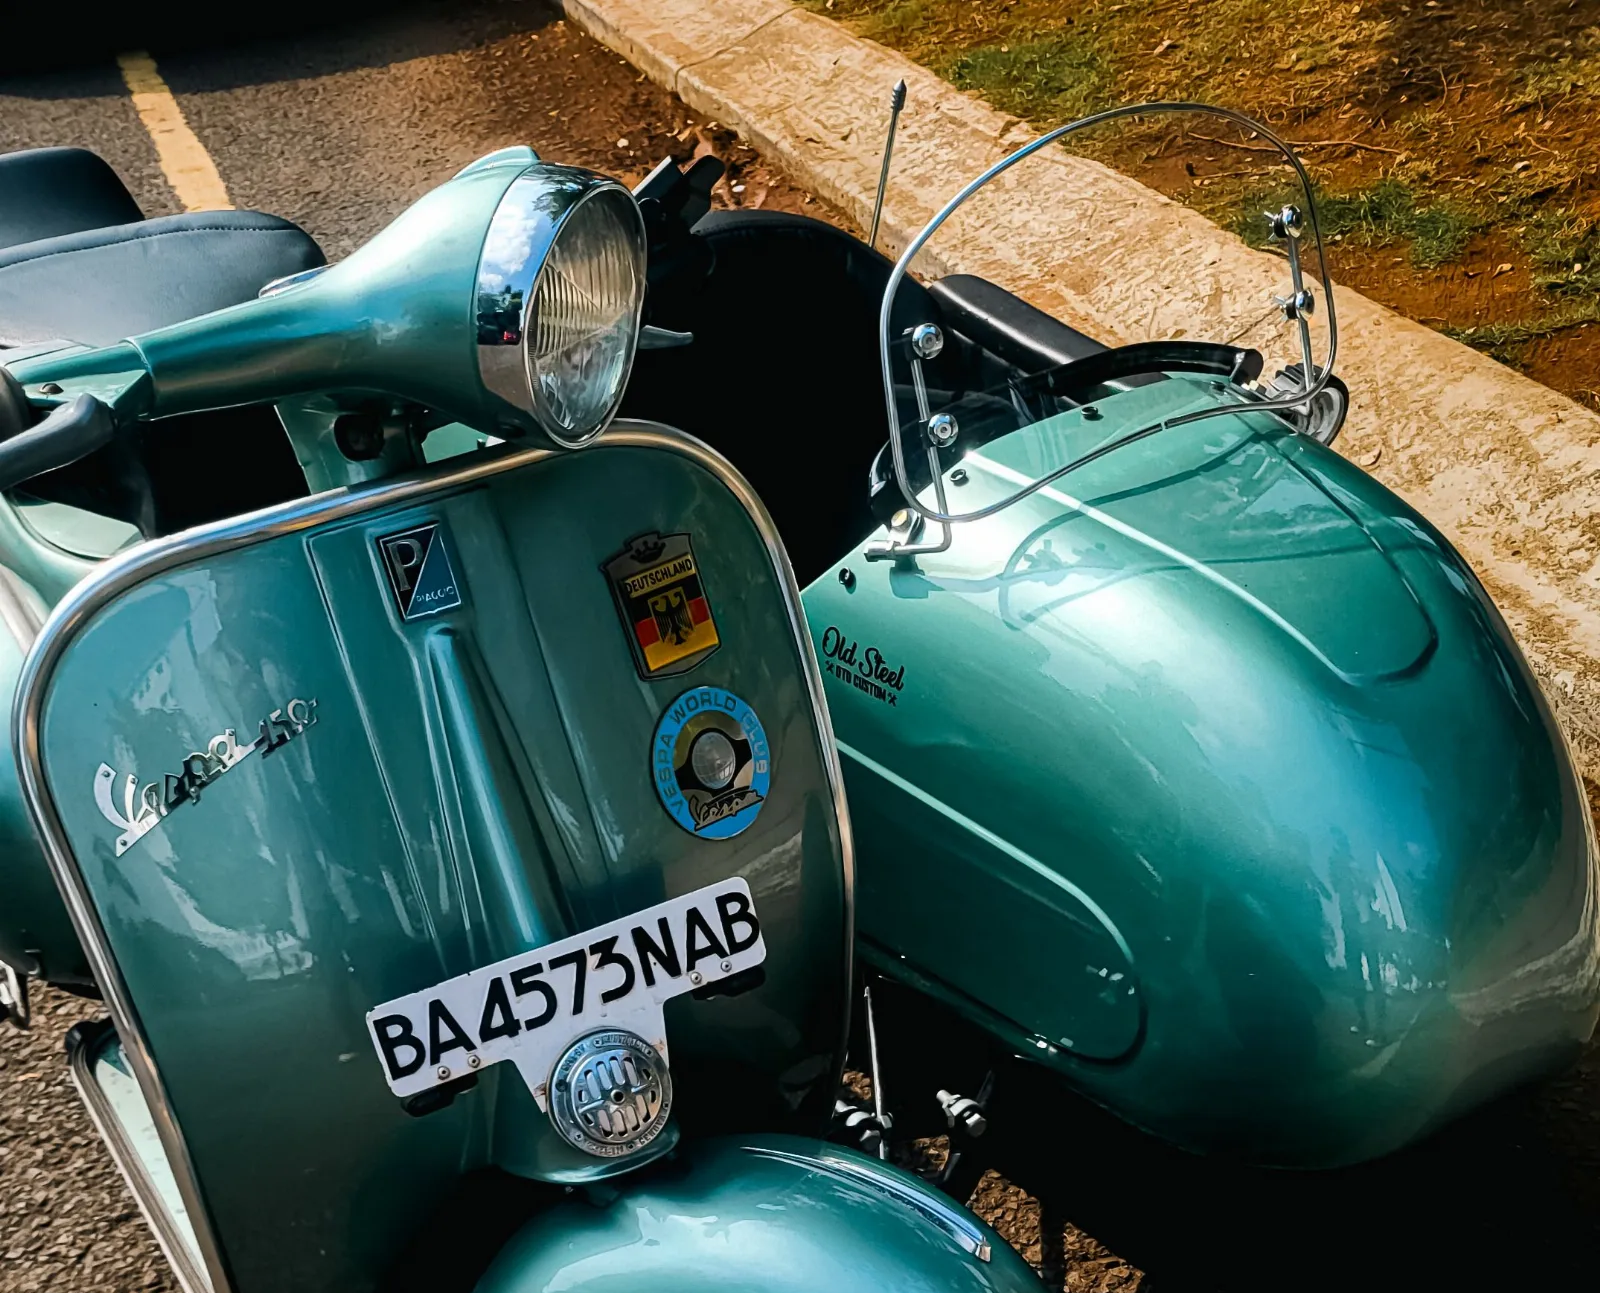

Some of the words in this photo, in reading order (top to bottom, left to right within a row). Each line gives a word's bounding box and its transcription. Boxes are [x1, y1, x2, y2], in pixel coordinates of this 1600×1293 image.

[625, 558, 693, 594] DEUTSCHLAND
[822, 626, 857, 667] Old
[858, 647, 905, 691] Steel
[853, 674, 887, 702] CUSTOM
[670, 691, 737, 725] WORLD
[657, 733, 684, 815] VESPA
[741, 711, 768, 774] CLUB
[373, 891, 760, 1081] BA4573NAB
